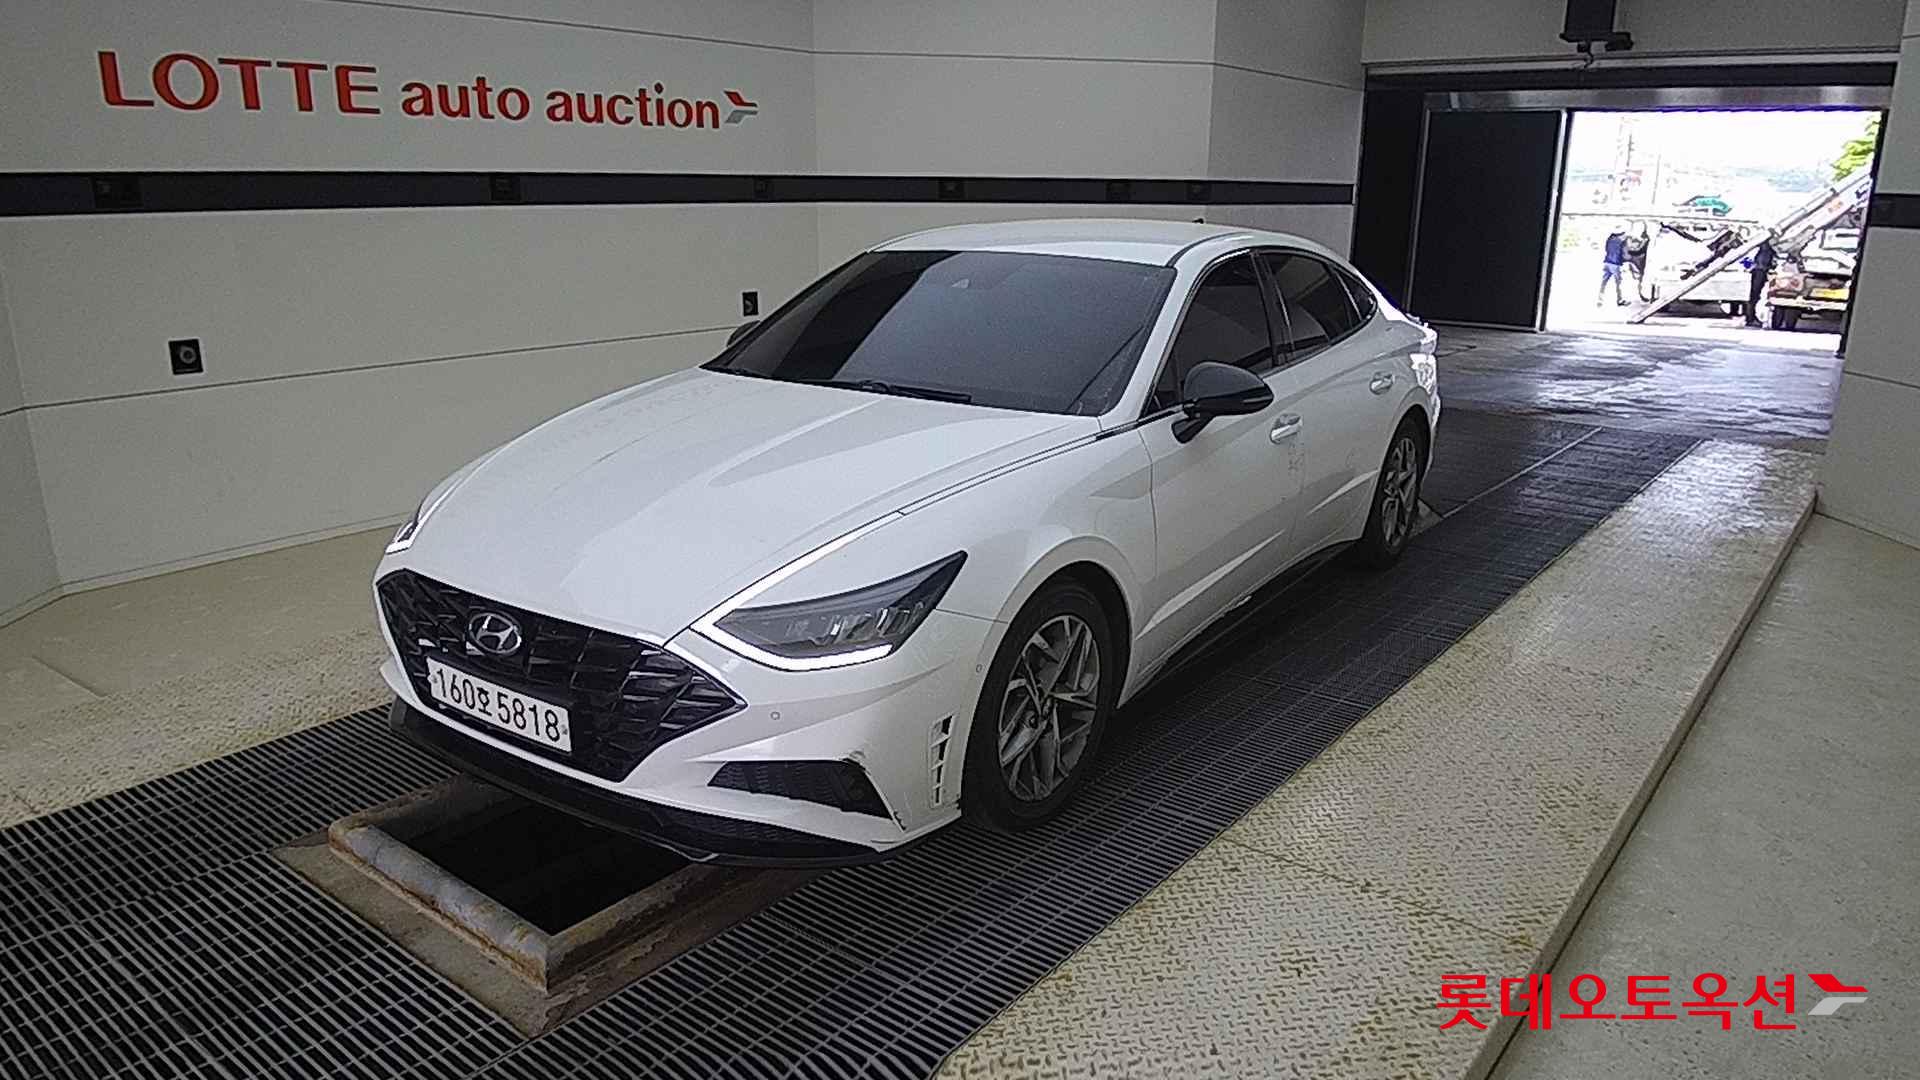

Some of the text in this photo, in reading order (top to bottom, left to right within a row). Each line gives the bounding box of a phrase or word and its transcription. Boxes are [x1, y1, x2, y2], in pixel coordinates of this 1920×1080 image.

[98, 51, 720, 129] LOTTE auto auction
[497, 691, 560, 742] 5818
